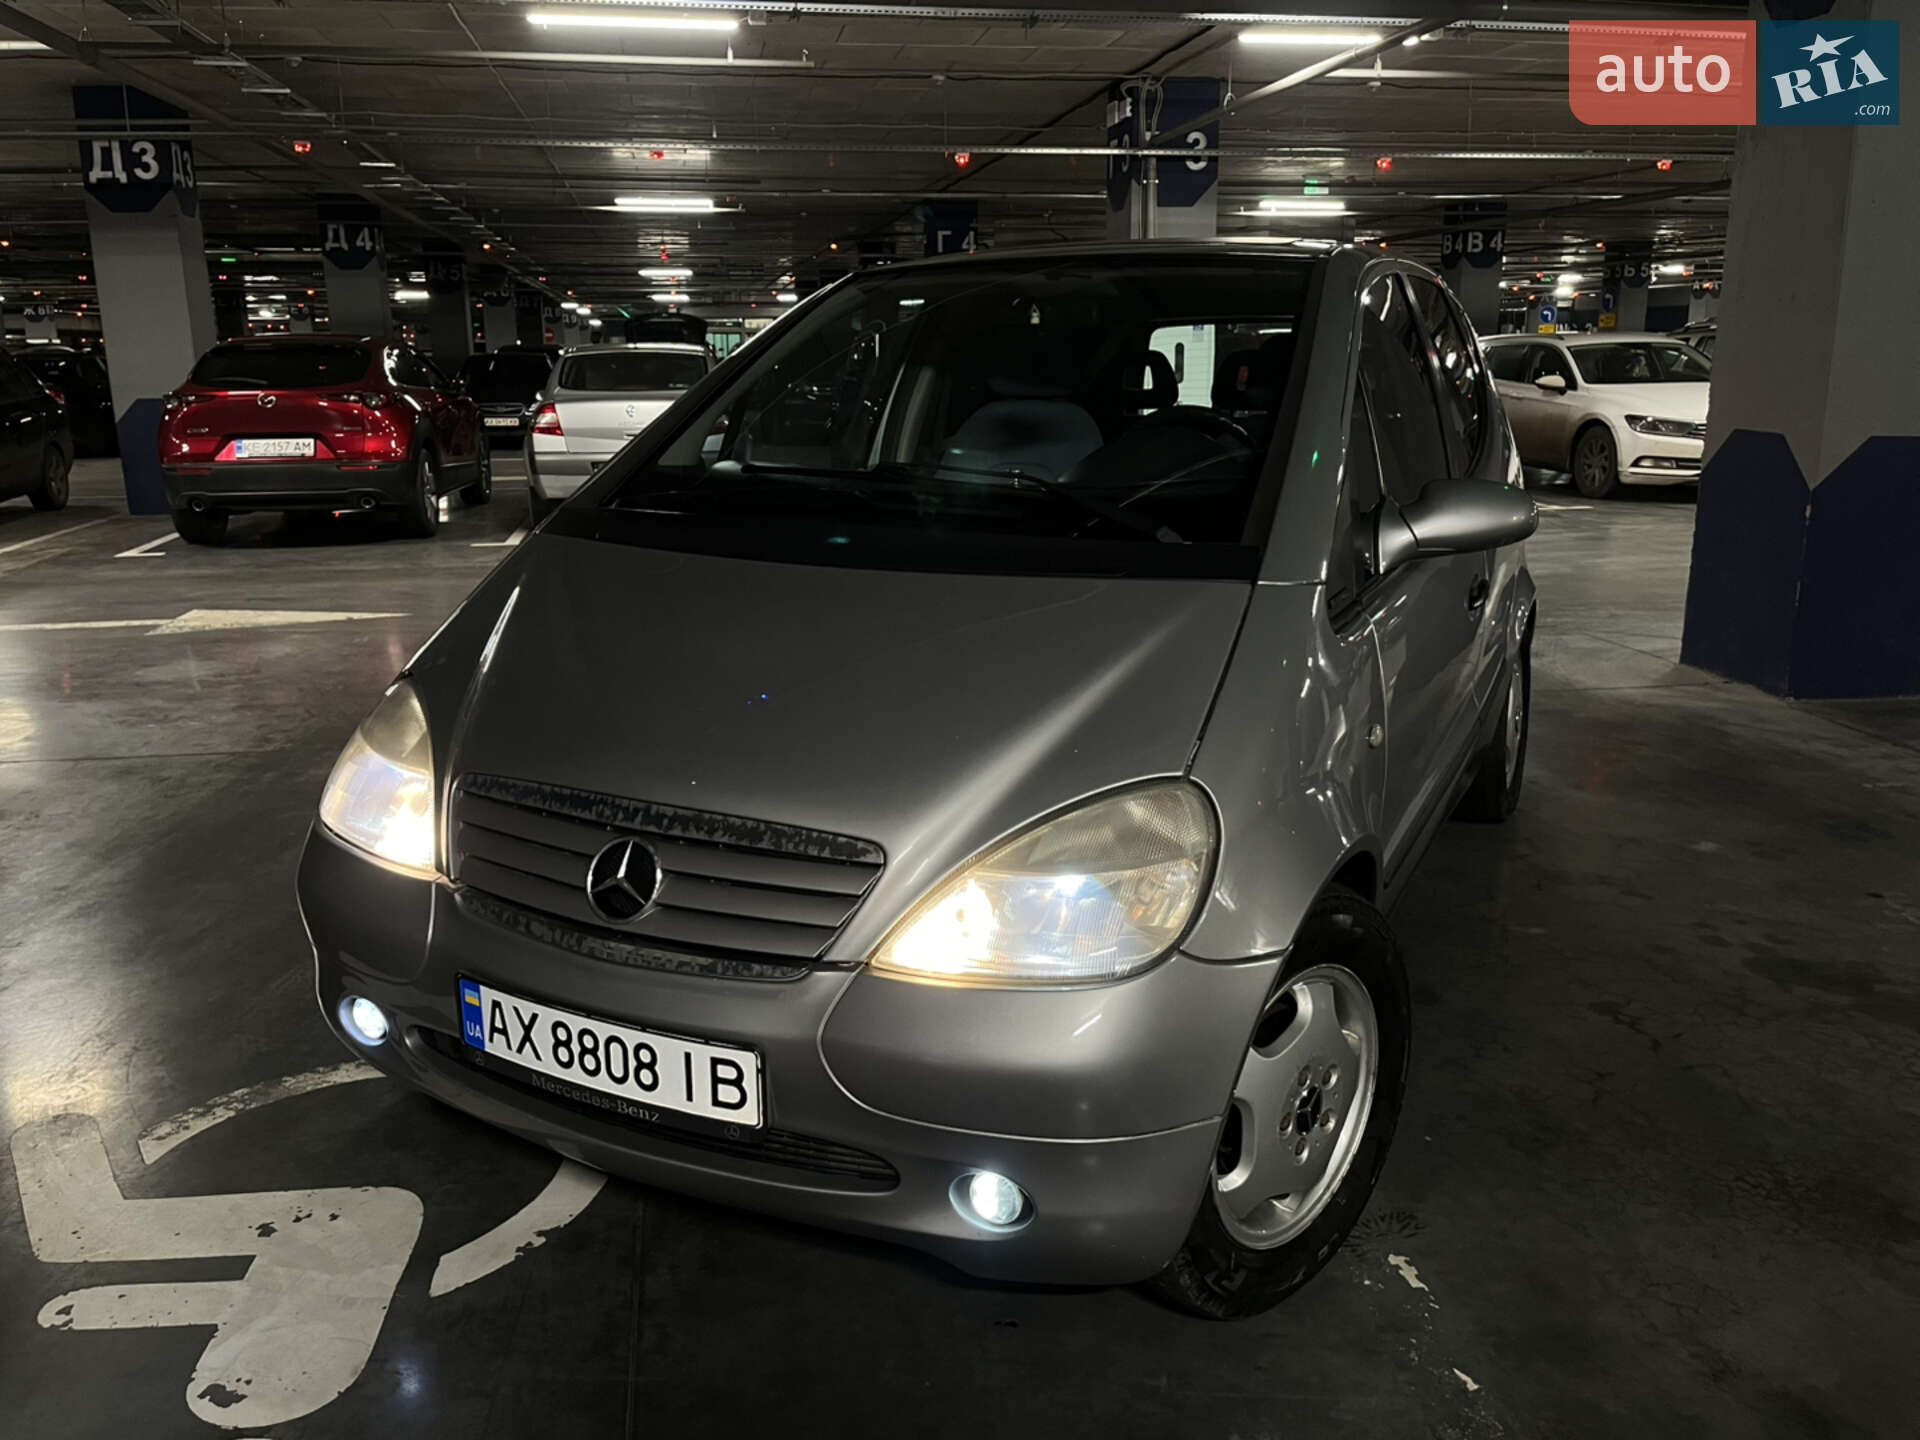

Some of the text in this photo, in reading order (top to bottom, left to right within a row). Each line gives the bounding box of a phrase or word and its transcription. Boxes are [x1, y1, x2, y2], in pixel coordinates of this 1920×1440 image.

[294, 441, 312, 451] AM
[466, 1020, 484, 1041] UA
[488, 1000, 542, 1062] AX
[551, 1020, 660, 1092] 8808
[531, 1073, 662, 1123] Mercedes-Benz
